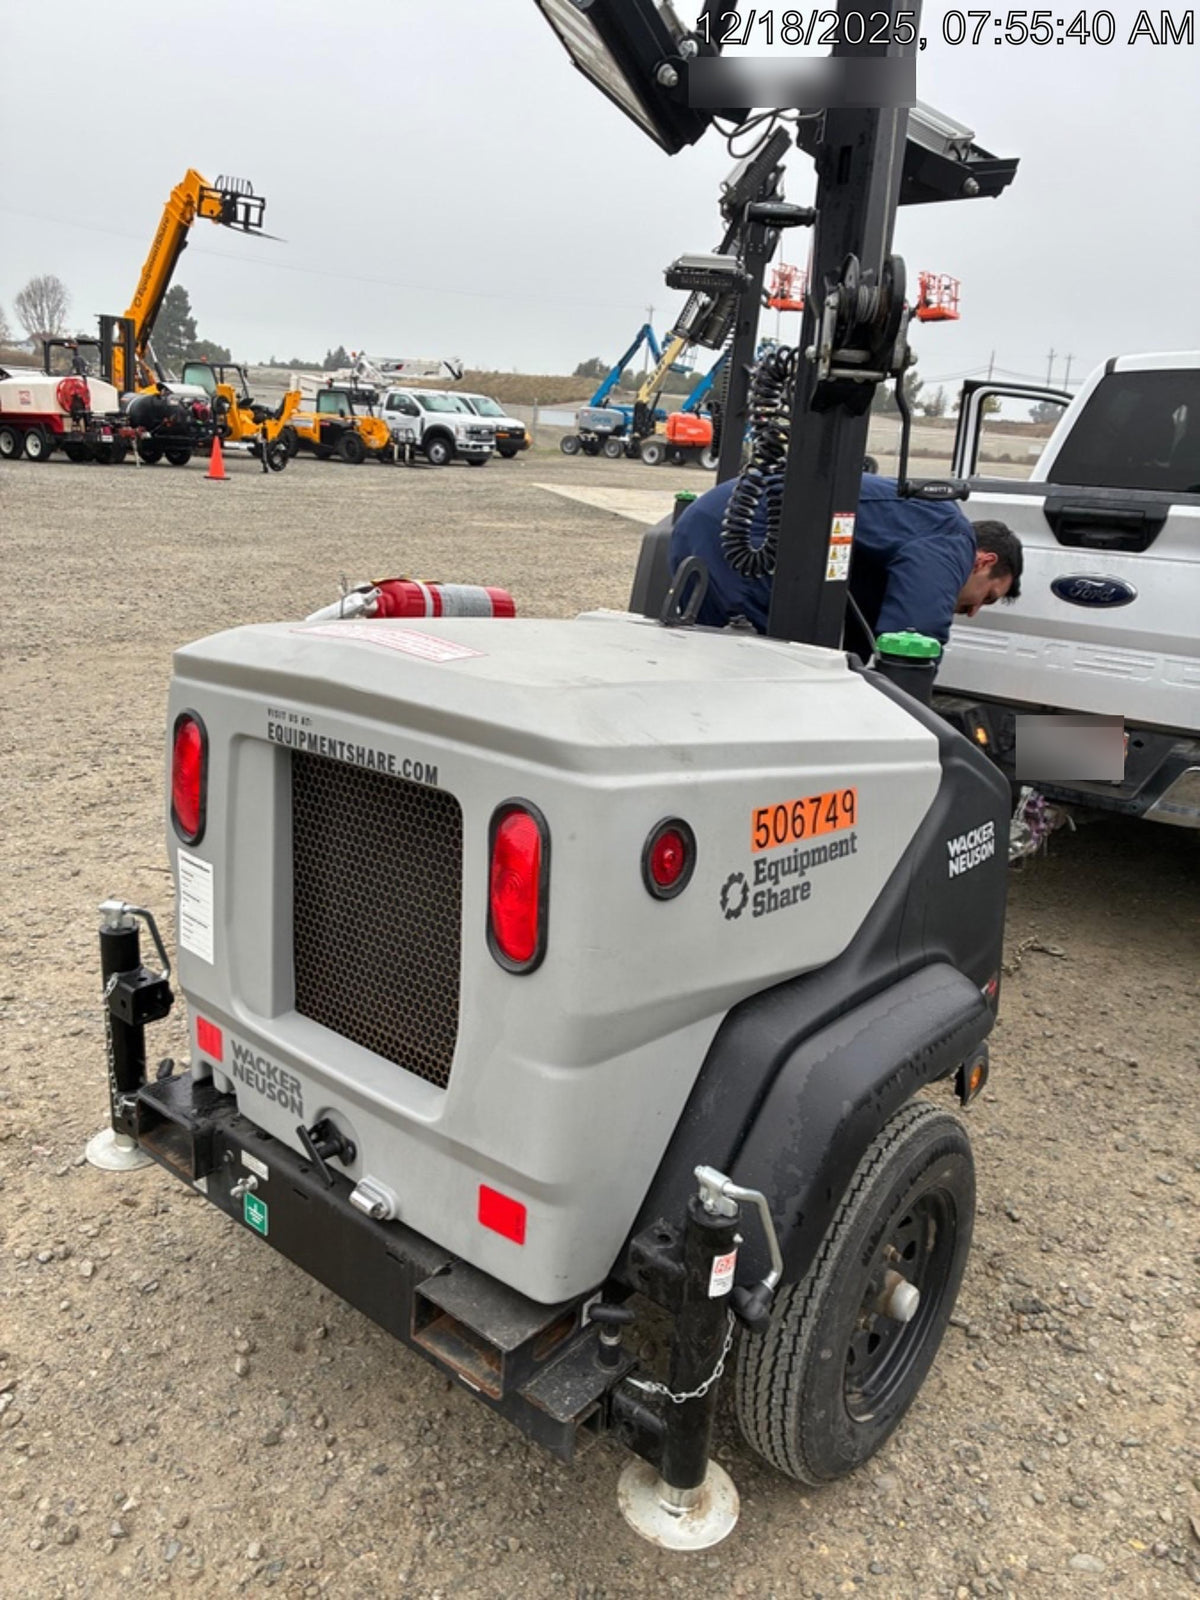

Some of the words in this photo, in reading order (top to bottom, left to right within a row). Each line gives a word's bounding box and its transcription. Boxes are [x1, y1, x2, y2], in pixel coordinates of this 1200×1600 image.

[1069, 578, 1116, 602] Ford
[267, 707, 287, 720] VISIT
[289, 713, 299, 724] US
[267, 721, 439, 786] EQUIPMENTSHARE.COM
[754, 789, 855, 849] 506749
[947, 820, 995, 858] WACKER
[752, 831, 858, 887] Equipment
[948, 838, 995, 878] NEUSON
[752, 880, 812, 918] Share
[231, 1039, 303, 1100] WACKER
[232, 1059, 304, 1120] NEUSON
